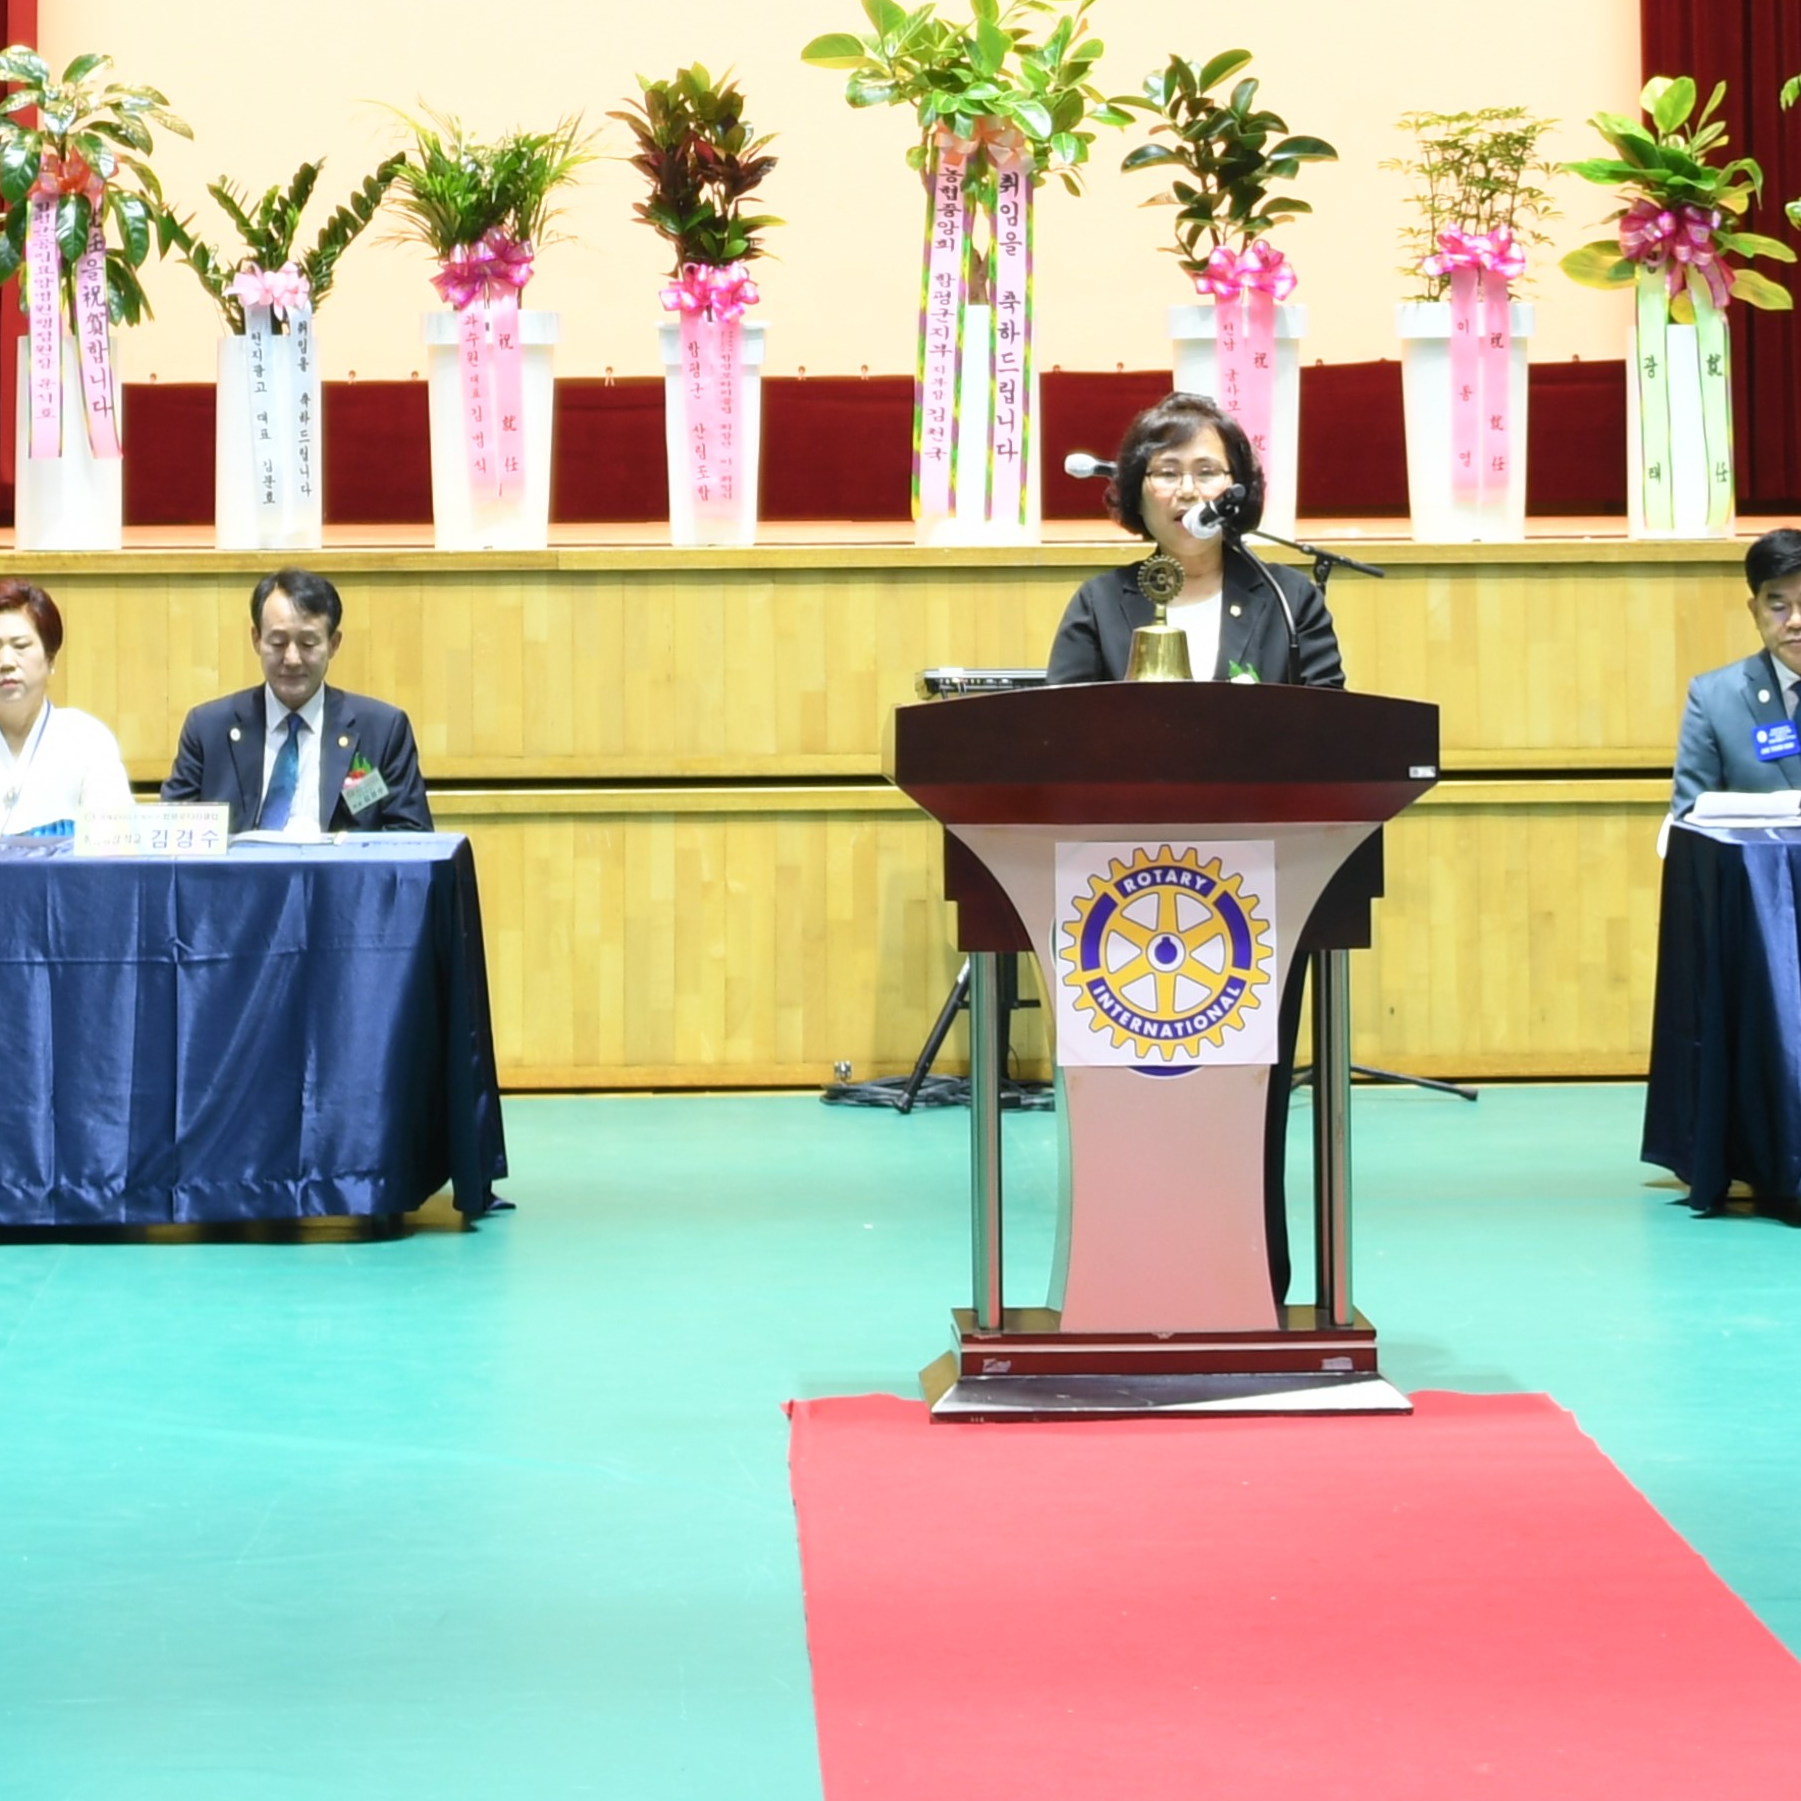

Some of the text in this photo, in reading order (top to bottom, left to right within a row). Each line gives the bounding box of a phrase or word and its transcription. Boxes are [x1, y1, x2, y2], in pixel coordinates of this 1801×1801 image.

[935, 166, 963, 252] 농협중앙회
[996, 170, 1023, 465] 취임을 축하드립니다
[297, 391, 313, 498] 축하드립니다
[151, 828, 220, 850] 김경수
[1123, 867, 1210, 896] ROTARY
[1092, 983, 1243, 1040] INTERNATIONAL
